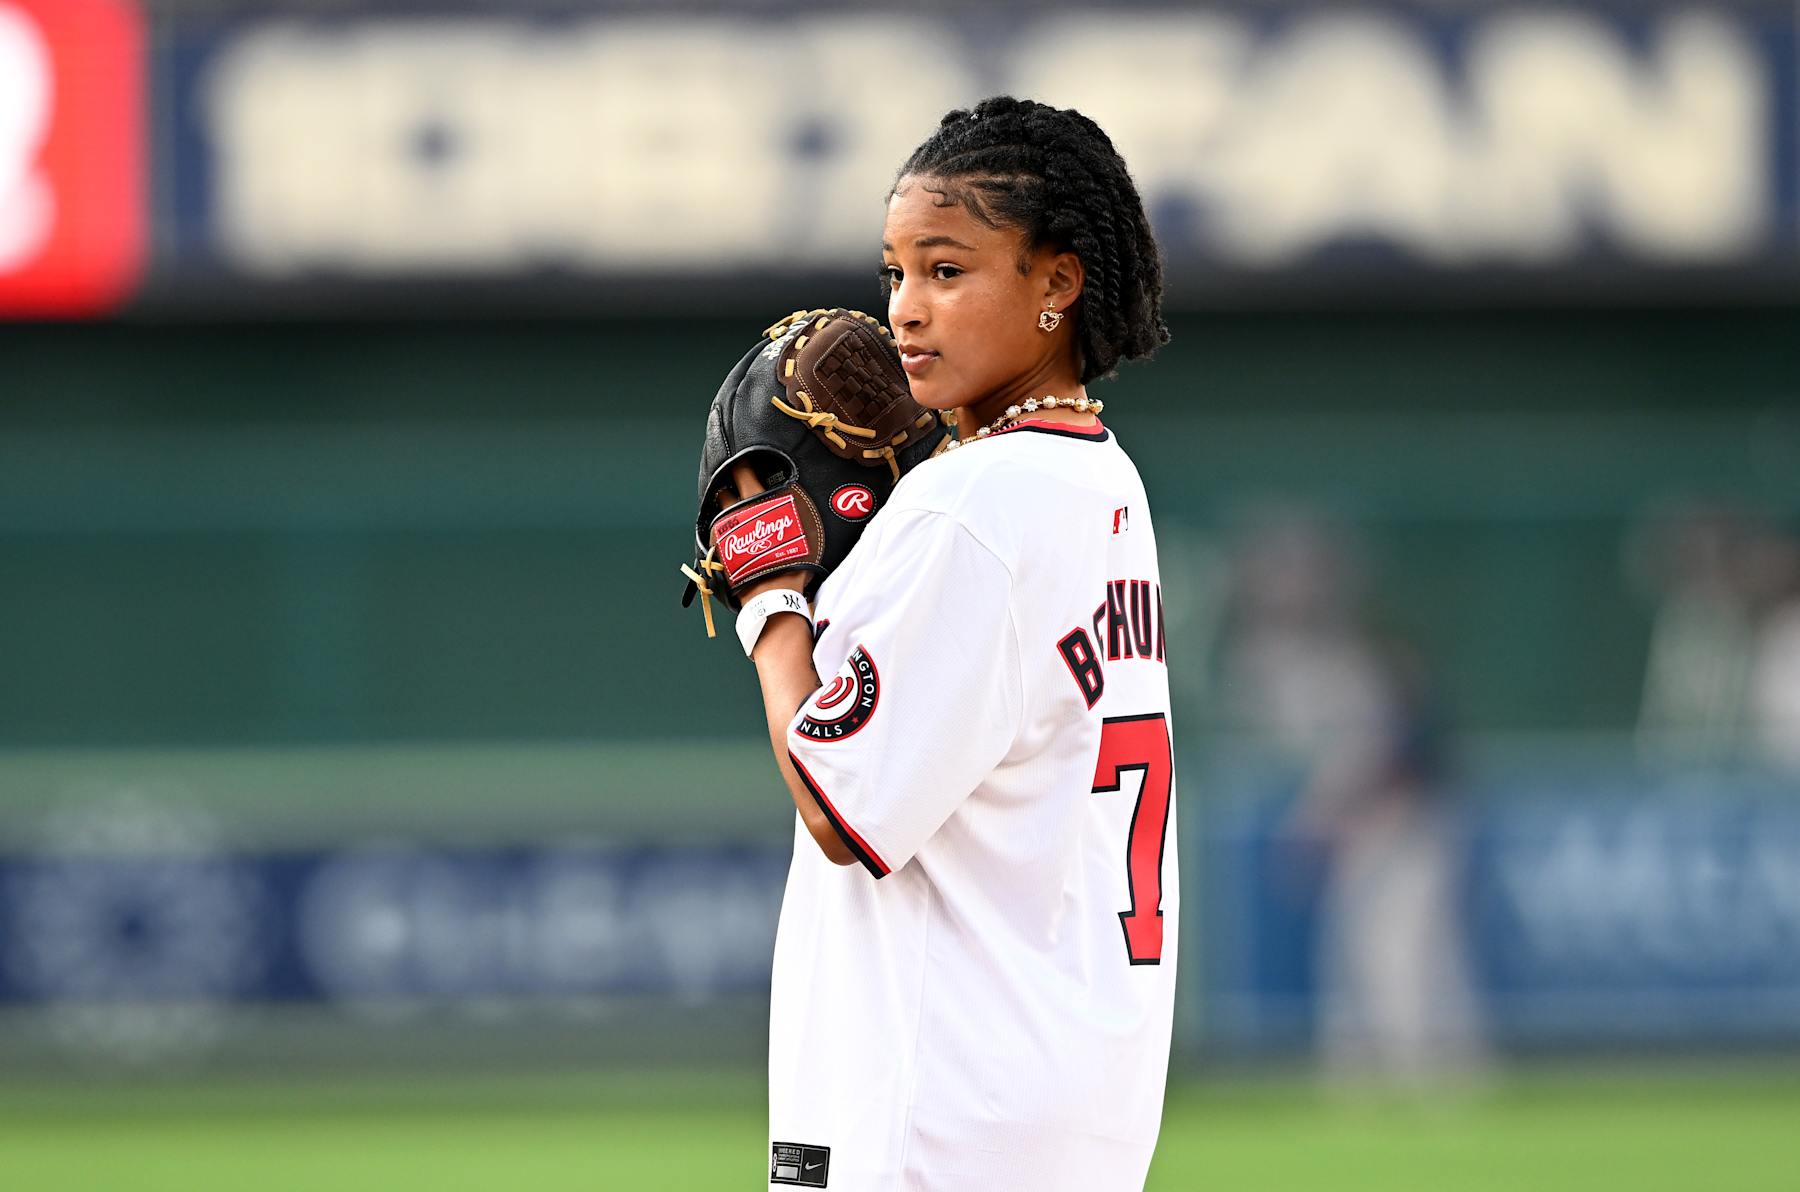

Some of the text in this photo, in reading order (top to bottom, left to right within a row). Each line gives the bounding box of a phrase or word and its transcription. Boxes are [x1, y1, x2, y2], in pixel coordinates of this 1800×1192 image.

[836, 489, 870, 513] R
[724, 516, 793, 560] Rawlings
[1091, 712, 1172, 966] 7
